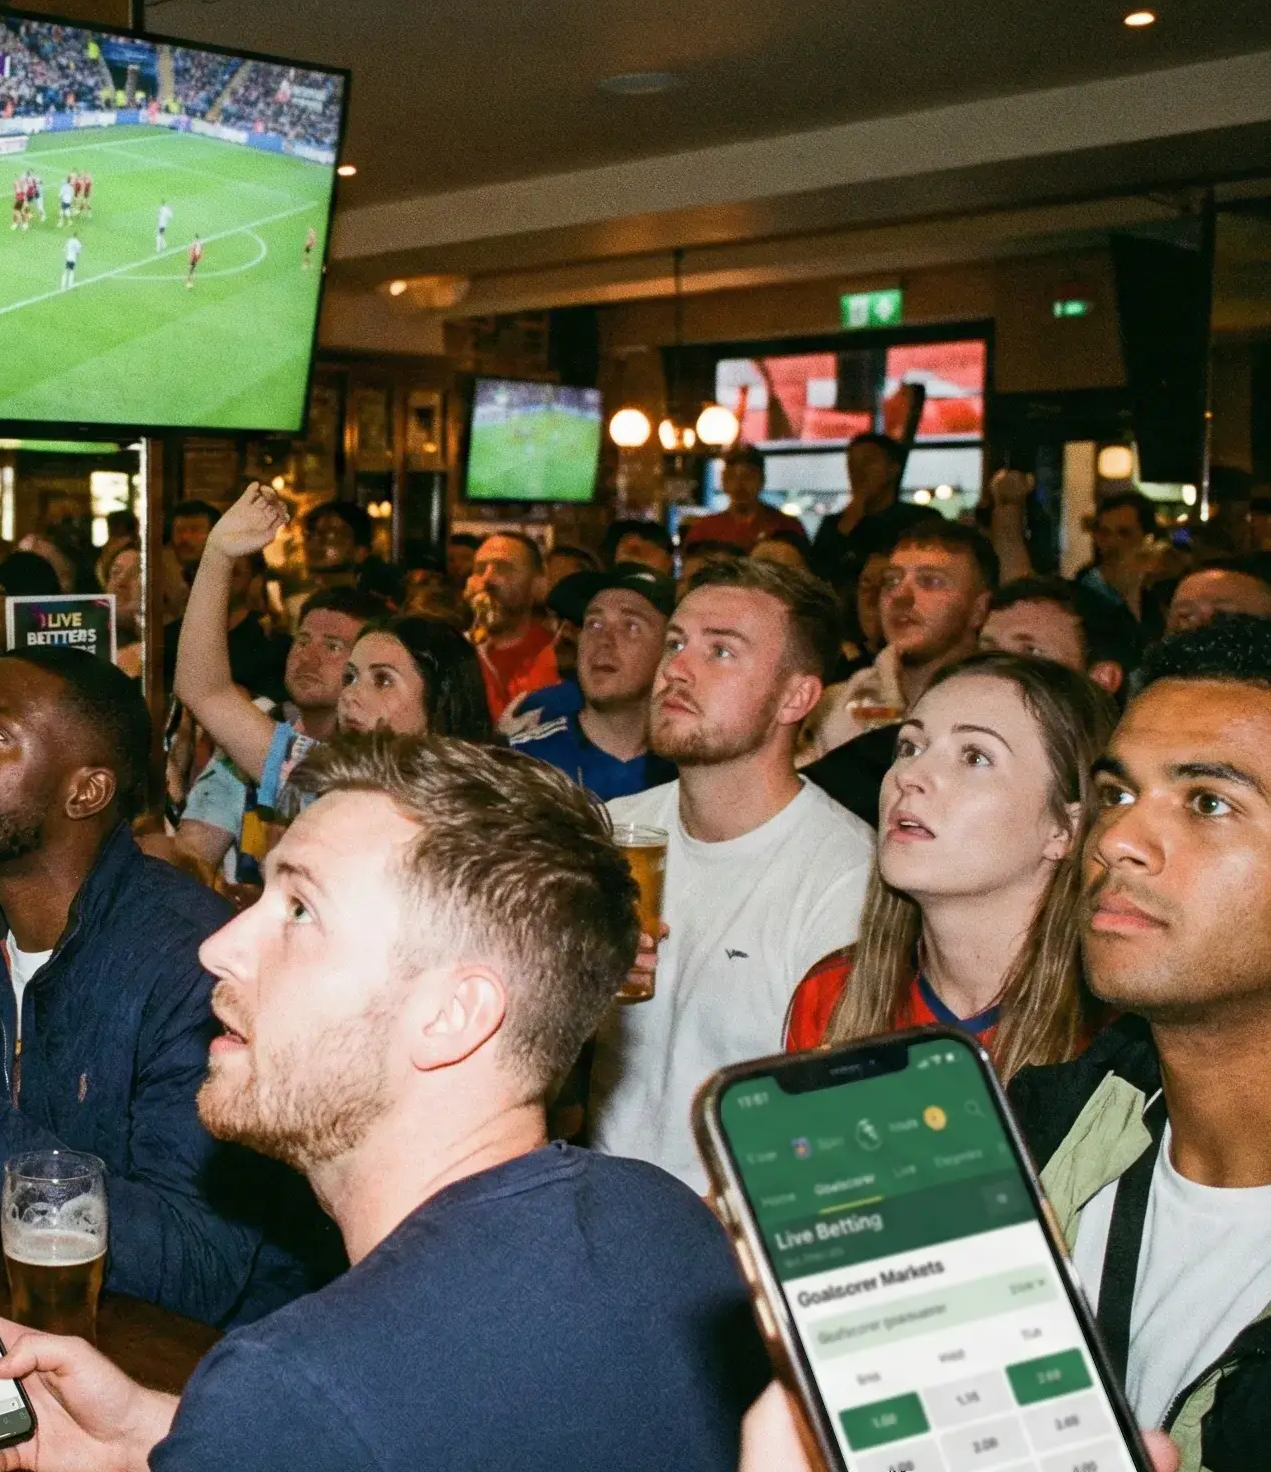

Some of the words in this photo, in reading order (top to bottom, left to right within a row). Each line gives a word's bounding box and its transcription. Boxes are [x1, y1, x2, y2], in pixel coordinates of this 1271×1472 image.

[48, 612, 82, 628] LIVE
[774, 1230, 814, 1251] Live
[815, 1213, 884, 1241] Betting
[880, 1260, 945, 1287] Markets
